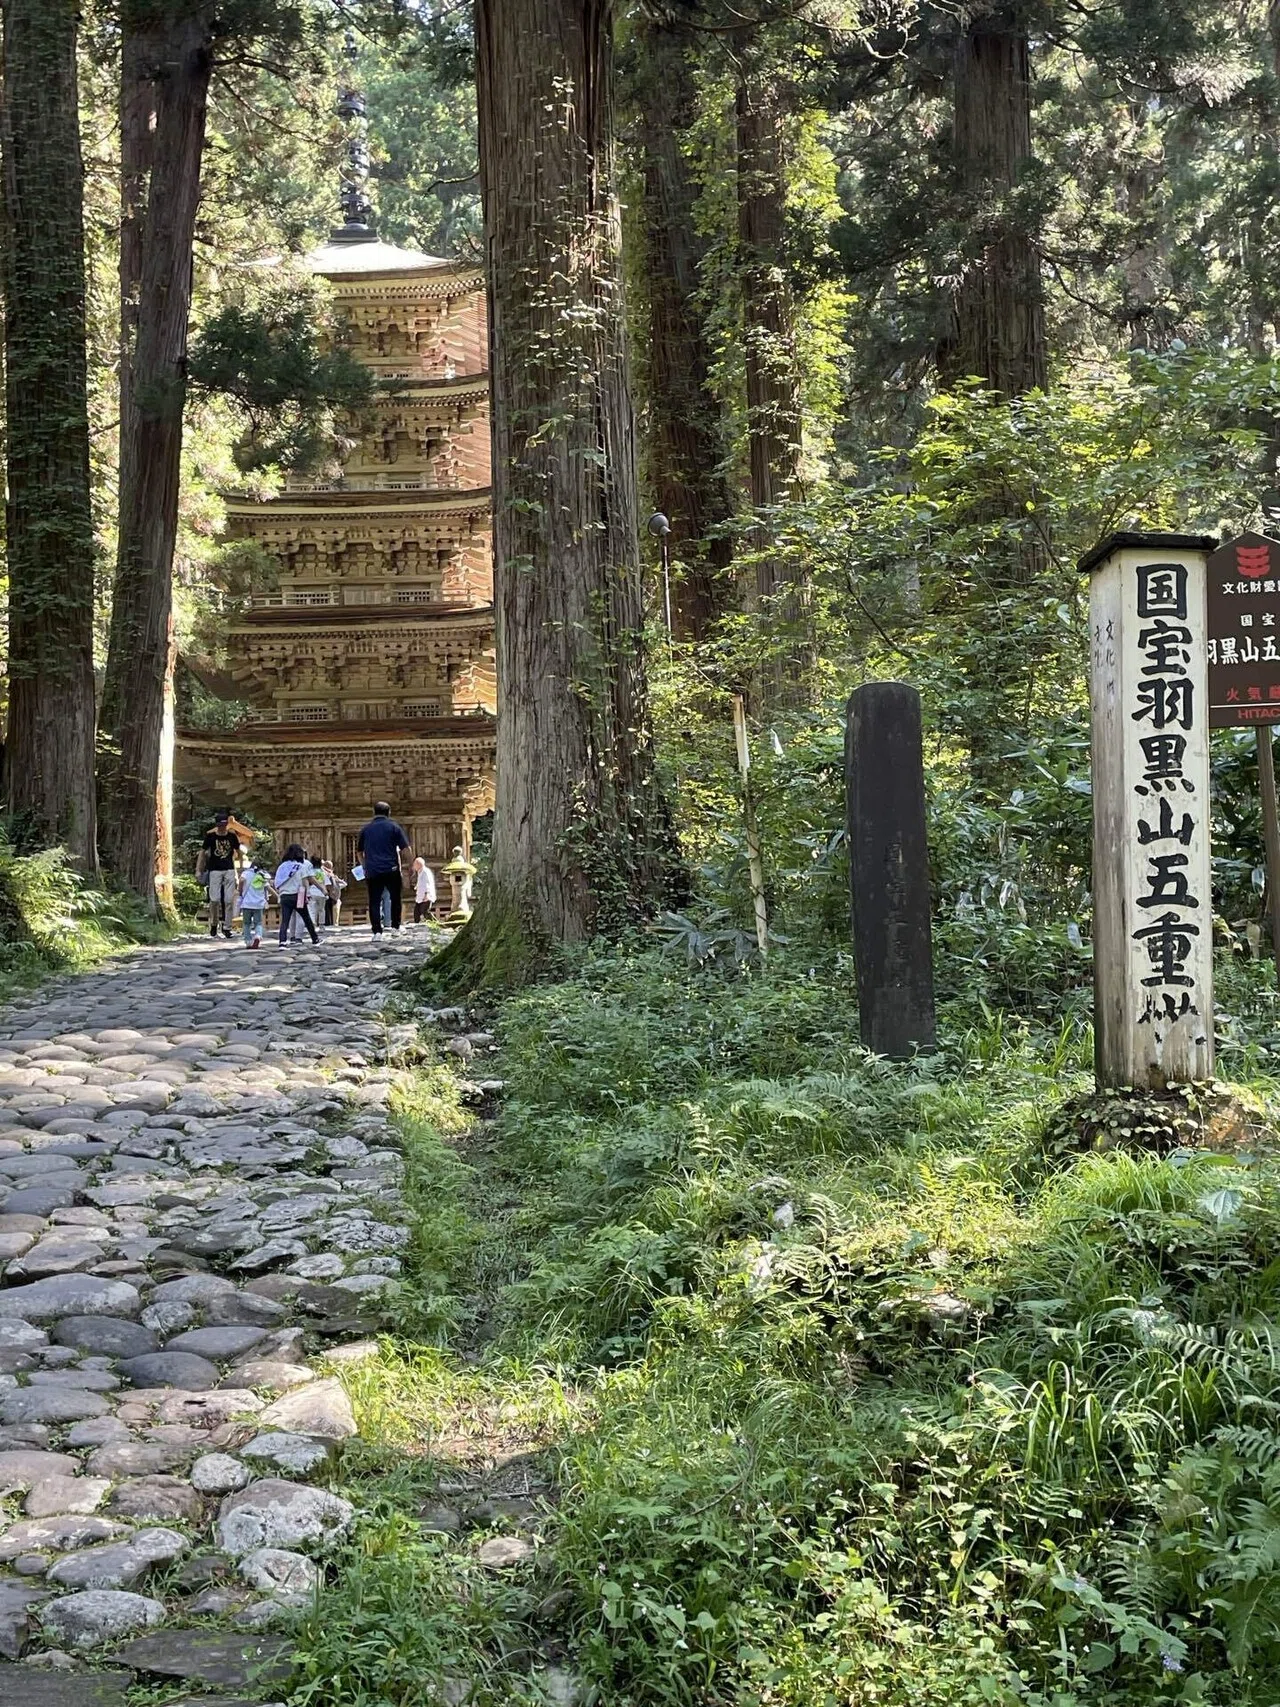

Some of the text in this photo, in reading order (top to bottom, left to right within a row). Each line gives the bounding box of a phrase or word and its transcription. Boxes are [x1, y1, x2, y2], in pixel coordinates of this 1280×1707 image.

[1222, 580, 1280, 594] 文化財愛
[1240, 612, 1275, 627] 国宝
